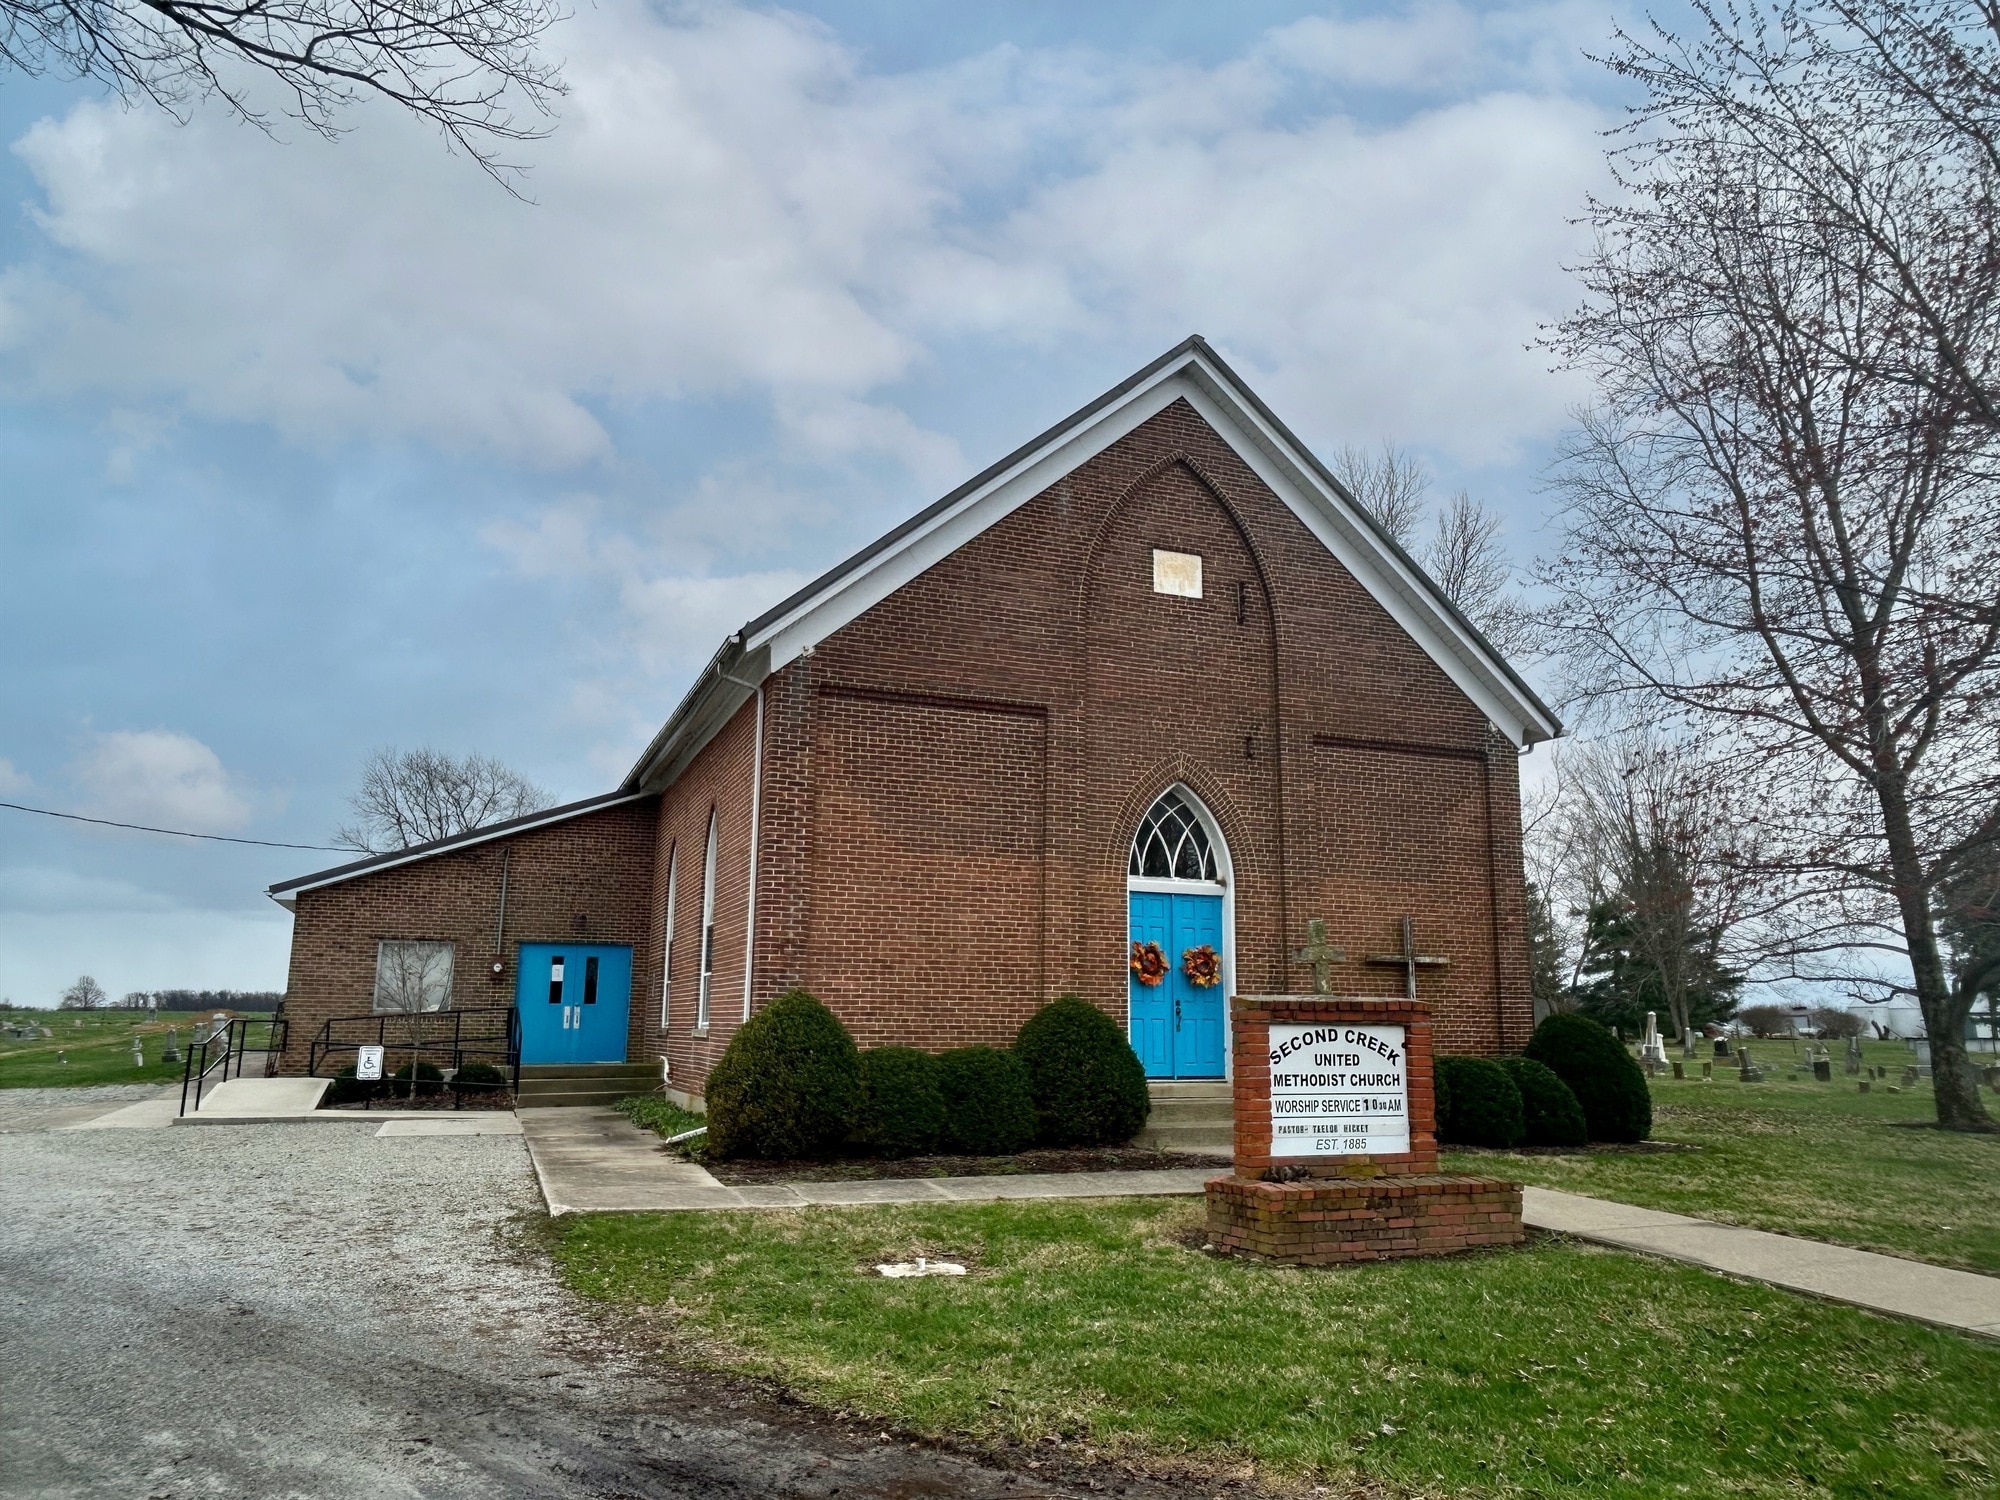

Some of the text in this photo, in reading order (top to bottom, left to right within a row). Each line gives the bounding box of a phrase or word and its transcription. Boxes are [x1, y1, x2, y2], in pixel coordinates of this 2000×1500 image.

[1270, 1029, 1400, 1066] SECOND CREEK
[1314, 1054, 1360, 1066] UNITED
[1273, 1073, 1400, 1087] METHODIST CHURCH
[1275, 1100, 1318, 1113] WORSHIP
[1321, 1099, 1361, 1112] SERVICE
[1316, 1138, 1367, 1150] EST. 1885
